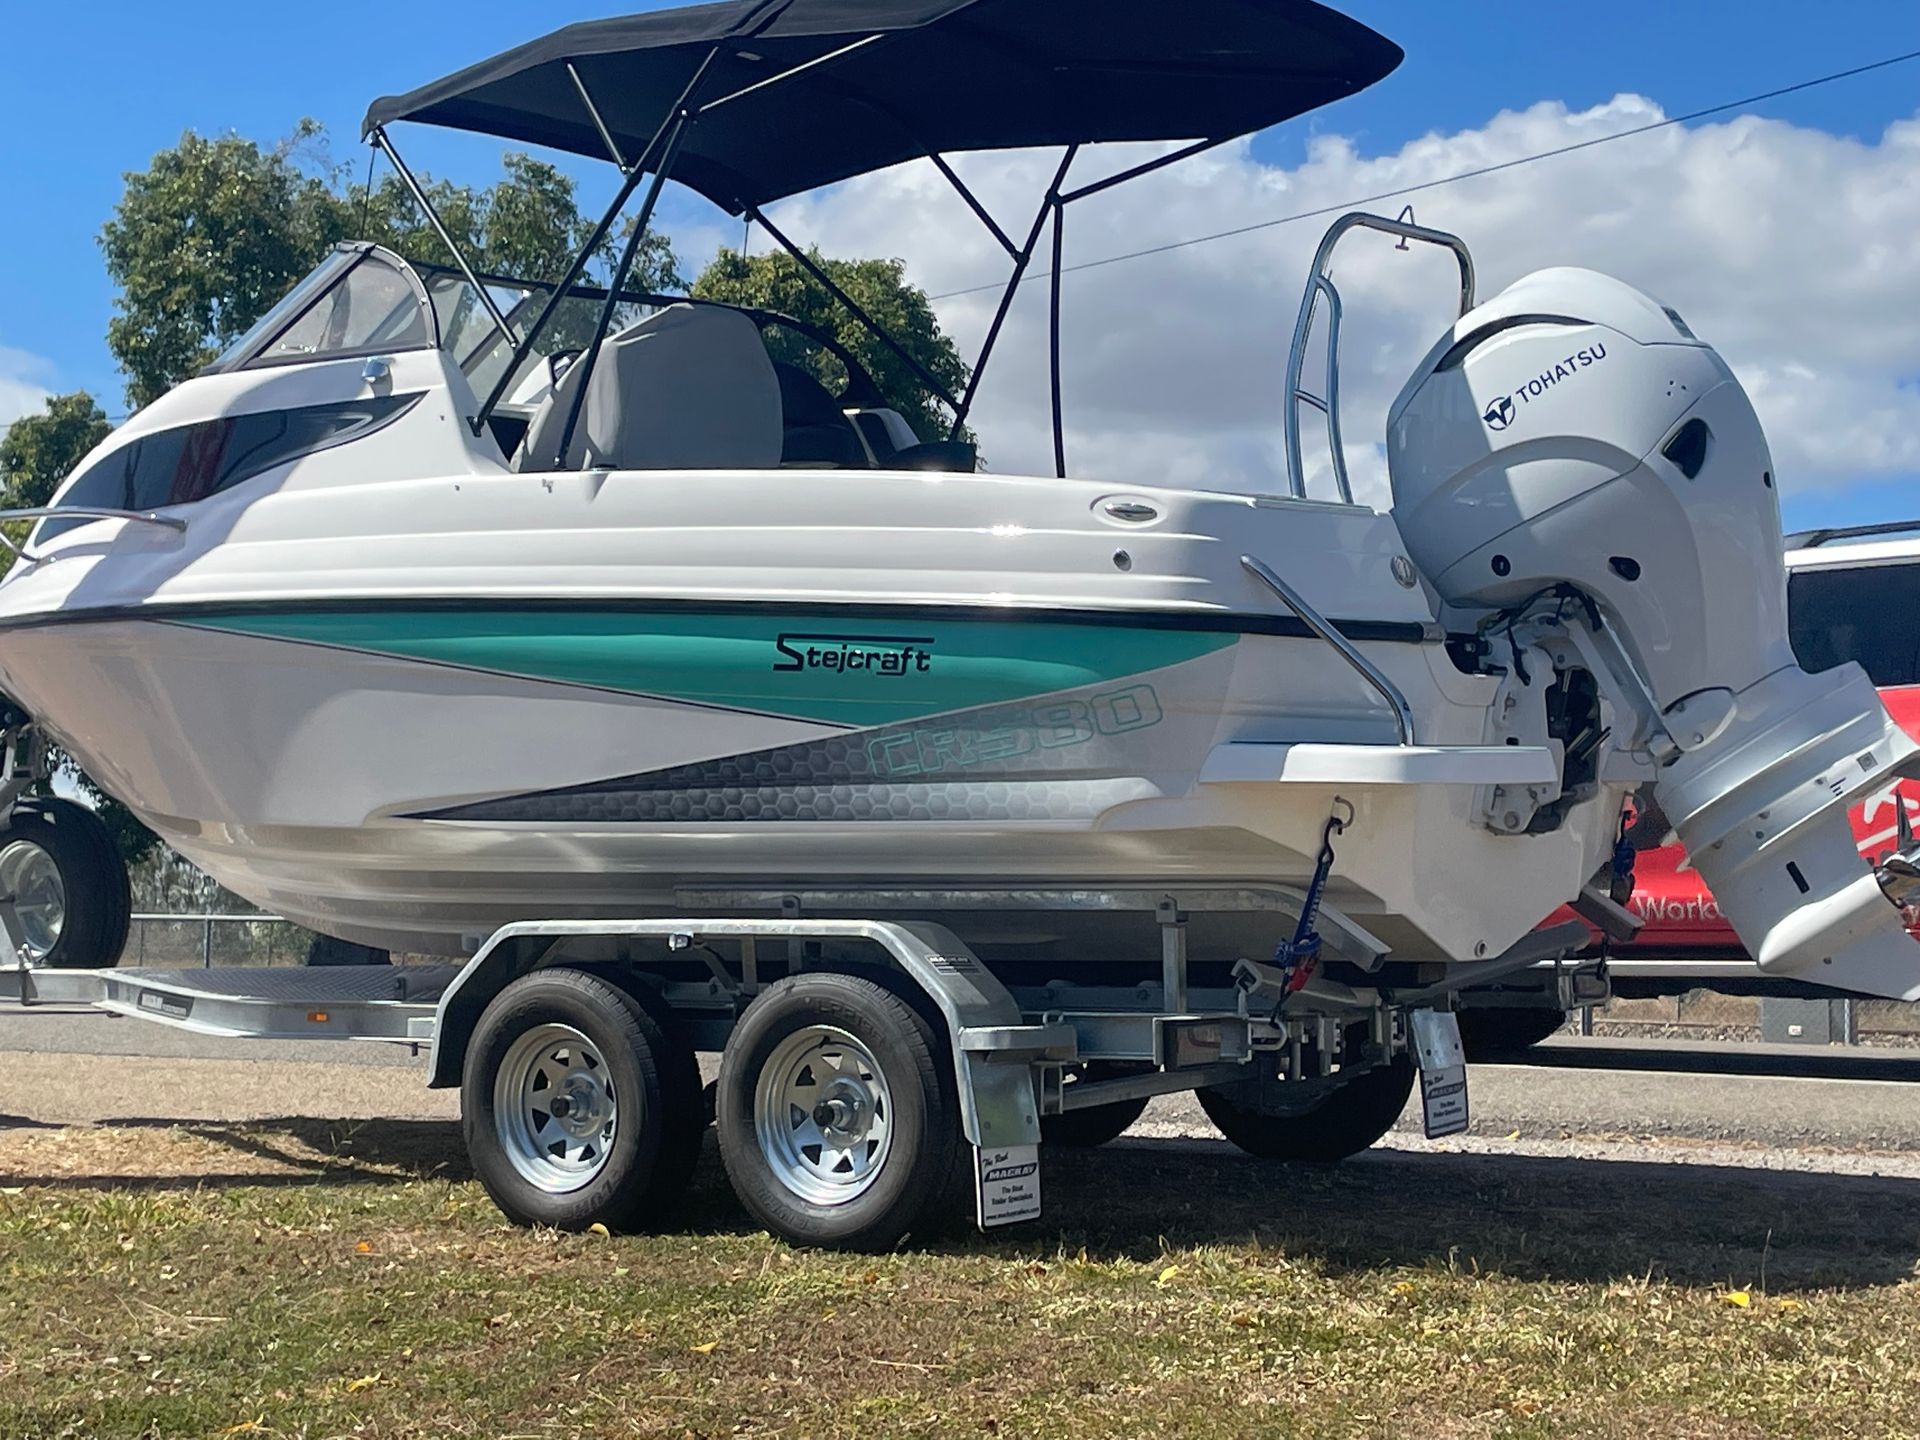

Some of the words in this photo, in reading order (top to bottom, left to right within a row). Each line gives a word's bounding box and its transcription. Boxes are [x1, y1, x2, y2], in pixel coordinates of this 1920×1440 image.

[1515, 342, 1607, 403] TOHATSU
[773, 633, 935, 676] Stejcraft
[868, 684, 1163, 778] CR580
